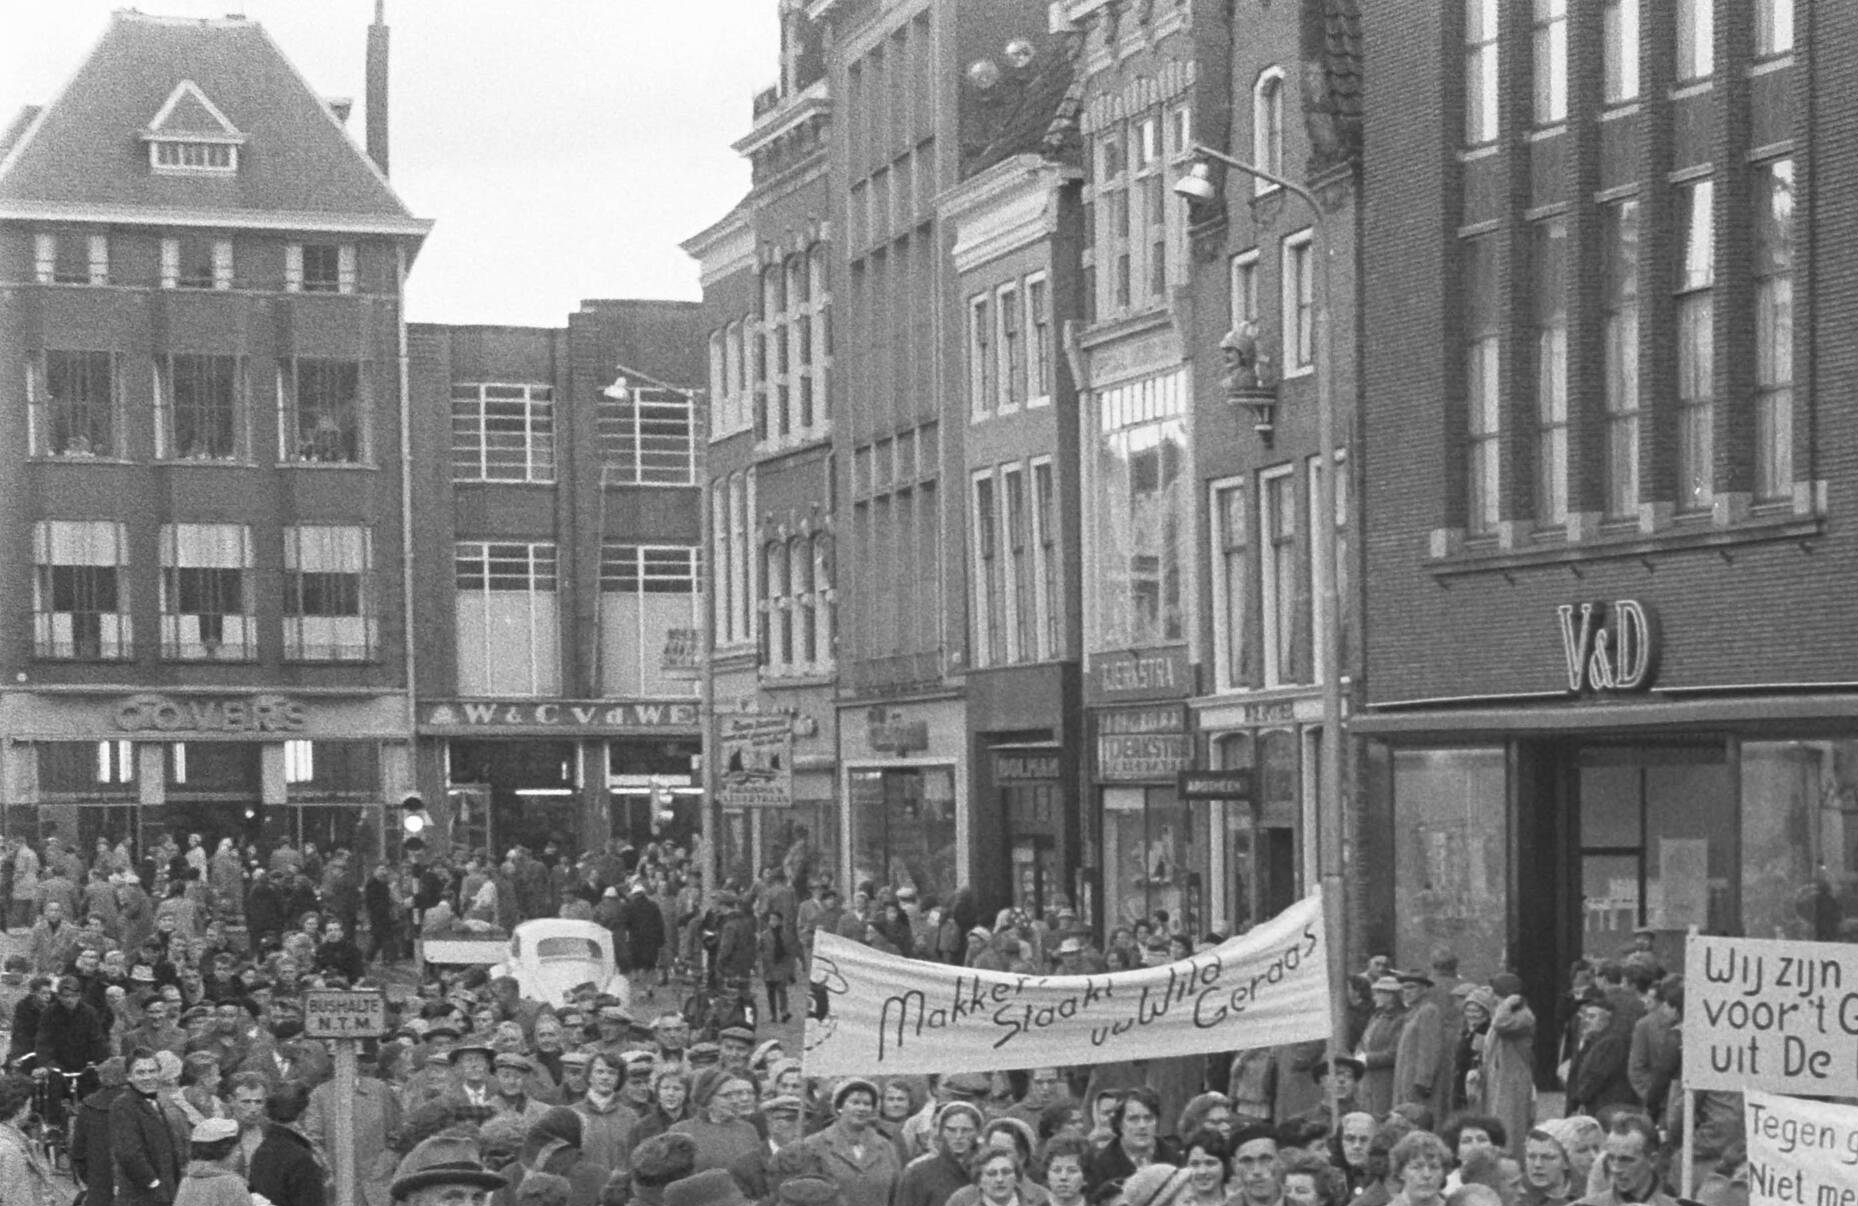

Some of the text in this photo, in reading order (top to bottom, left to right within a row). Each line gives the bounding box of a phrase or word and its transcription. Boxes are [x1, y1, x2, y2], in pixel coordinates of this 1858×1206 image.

[463, 702, 498, 724] W
[1138, 954, 1222, 1026] Wild
[1193, 921, 1317, 1029] Geraas
[1705, 947, 1763, 997] Wij
[1775, 956, 1841, 998] zijn
[309, 999, 379, 1014] BUSHALTE
[1702, 998, 1800, 1031] voor
[1710, 1036, 1760, 1075] uit
[1783, 1034, 1832, 1079] De
[1747, 1101, 1836, 1154] Tegen
[1748, 1162, 1805, 1206] Niet
